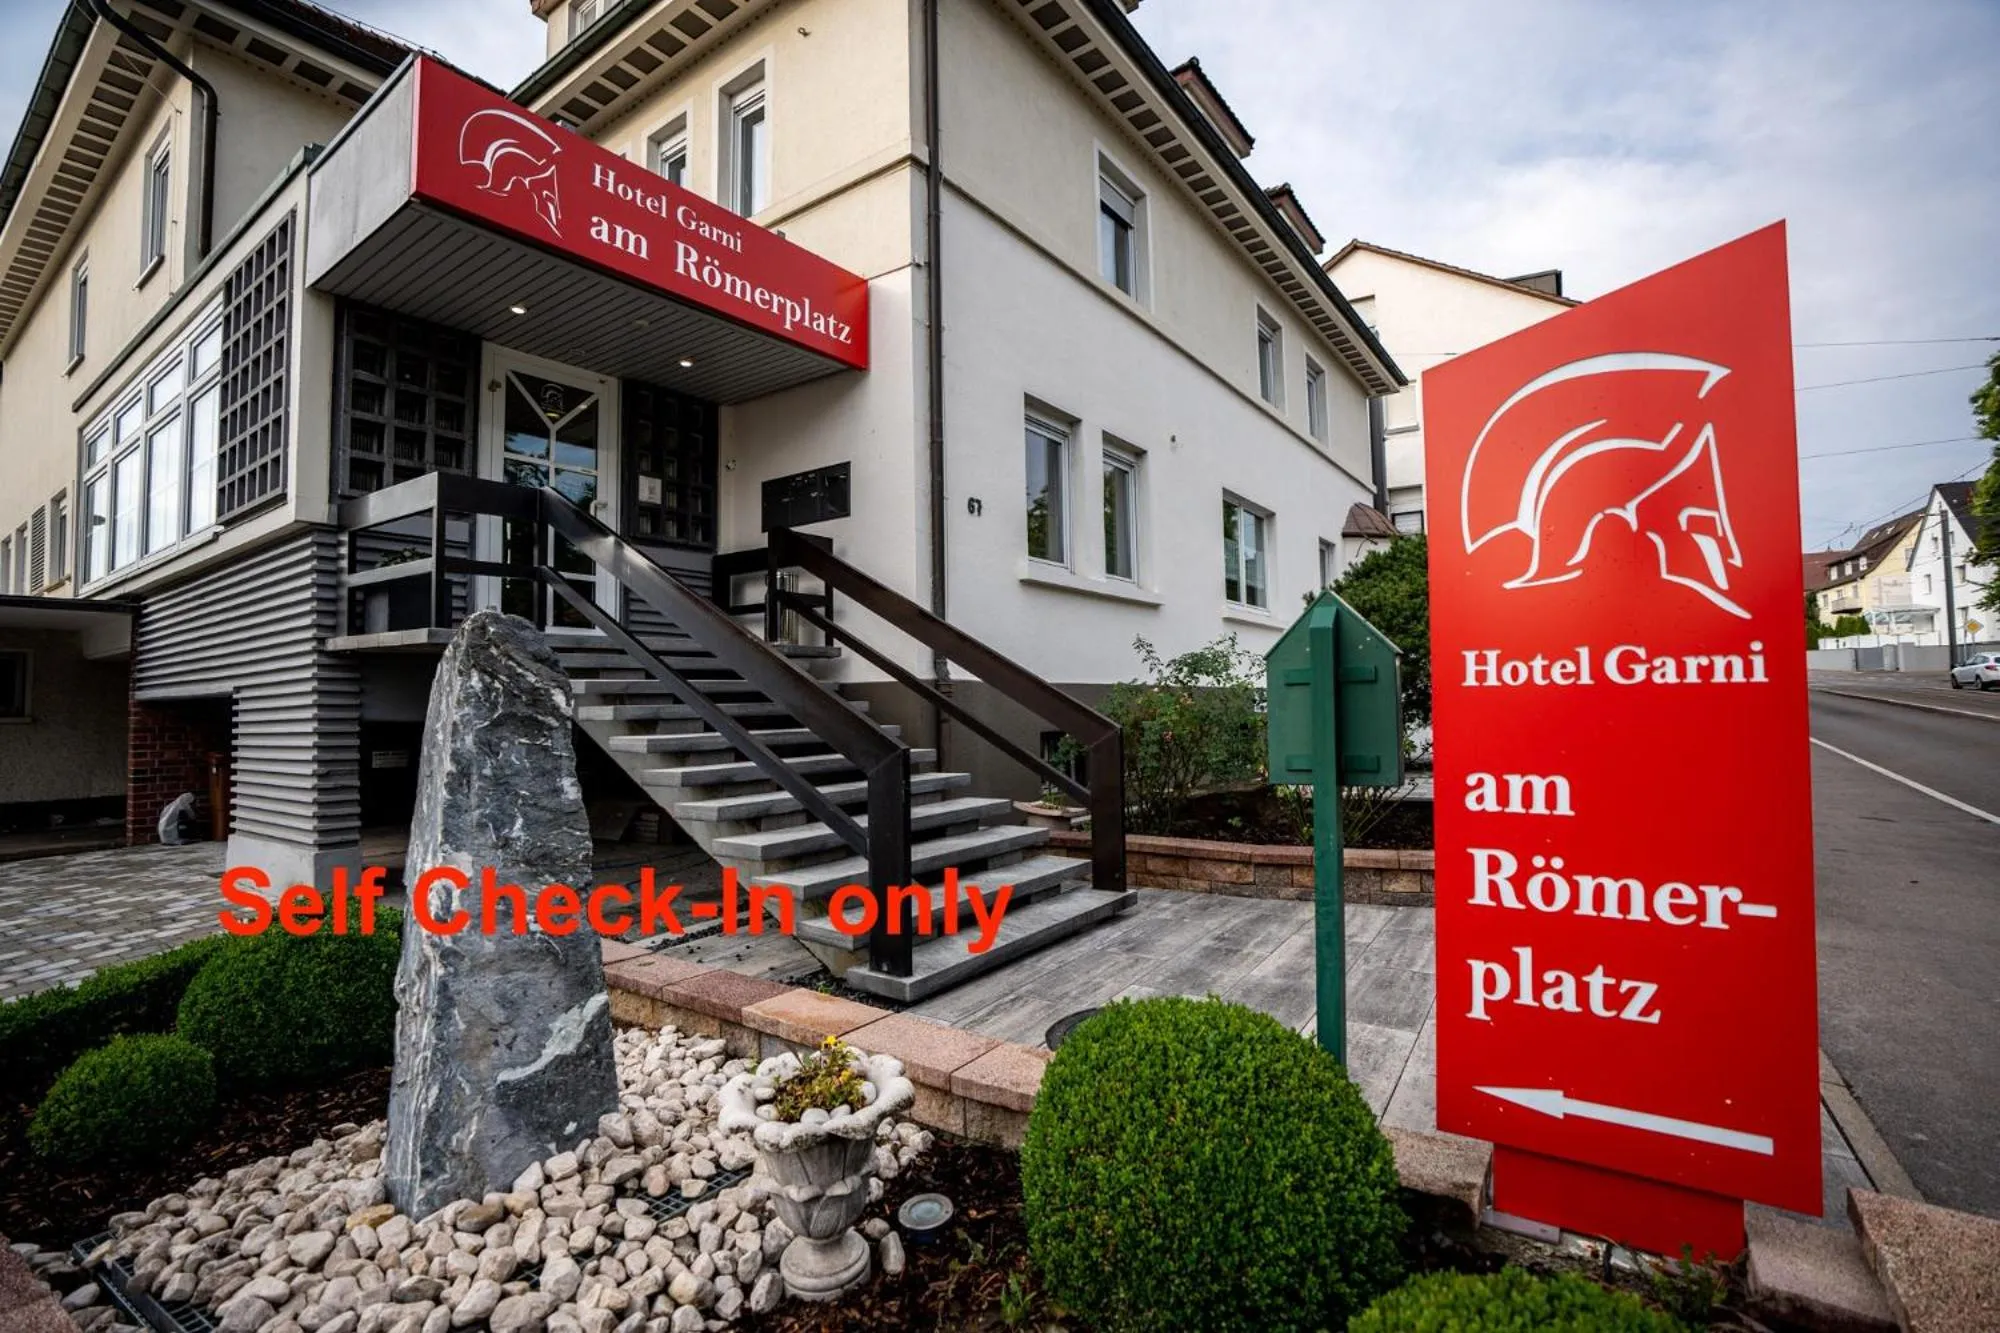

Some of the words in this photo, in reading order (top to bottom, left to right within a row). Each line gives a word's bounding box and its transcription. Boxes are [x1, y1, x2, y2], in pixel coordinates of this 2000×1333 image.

[592, 163, 668, 220] Hotel
[676, 204, 743, 254] Garni
[589, 214, 649, 261] am
[673, 239, 853, 345] Römerplatz
[967, 496, 982, 517] 67
[1461, 646, 1595, 687] Hotel
[1603, 640, 1769, 685] Garni
[1464, 771, 1576, 816] am
[1466, 847, 1778, 930] Römer-
[1465, 945, 1662, 1025] platz
